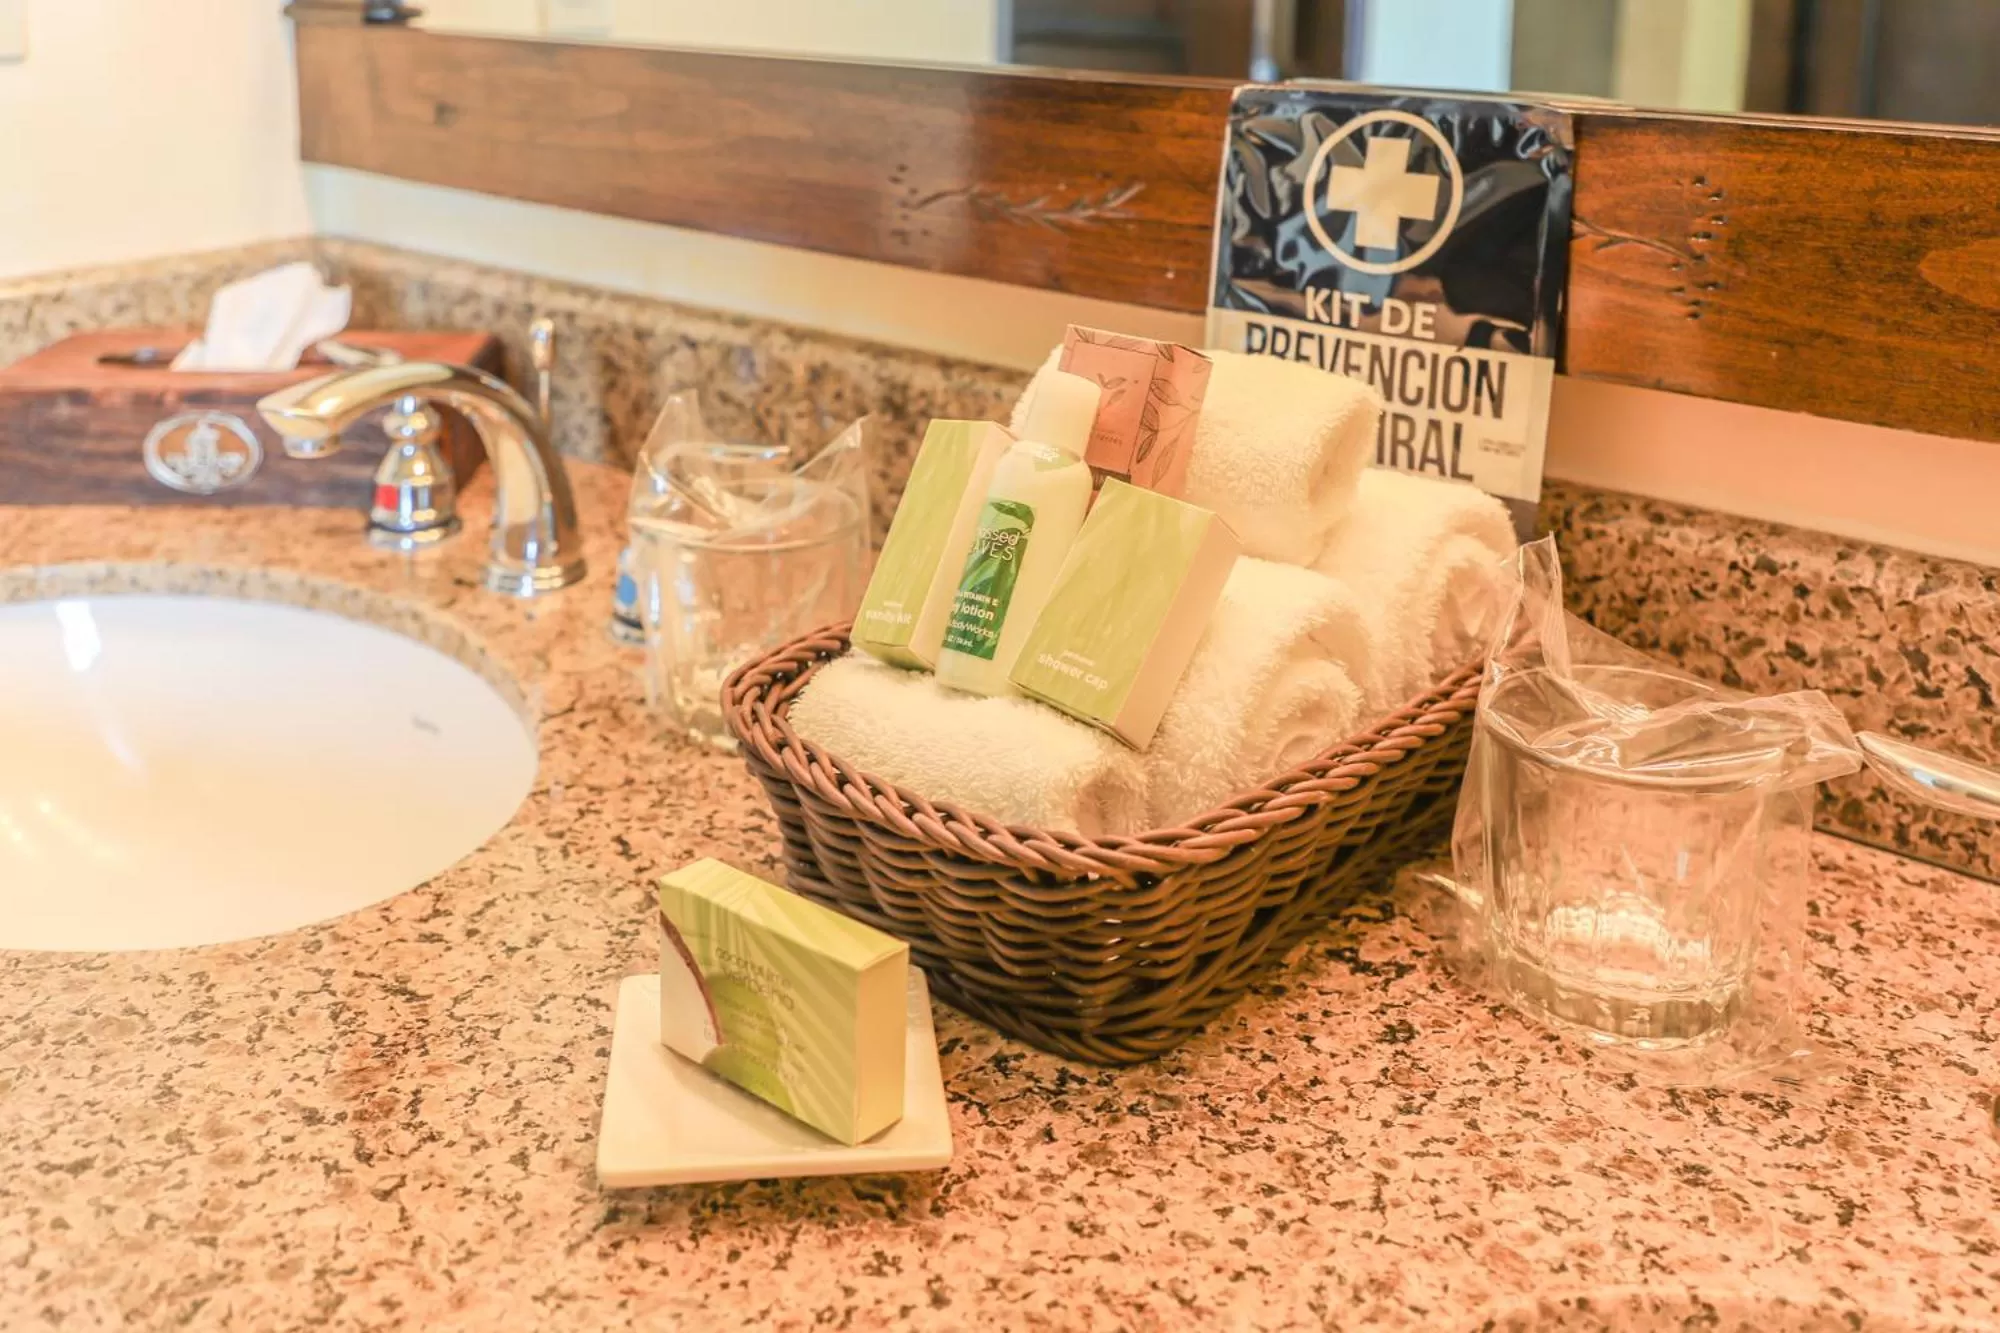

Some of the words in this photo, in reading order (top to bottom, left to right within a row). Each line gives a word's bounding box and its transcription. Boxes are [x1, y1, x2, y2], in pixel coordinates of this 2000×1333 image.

[1305, 286, 1371, 329] KIT
[1379, 297, 1438, 340] DE
[1376, 411, 1473, 482] IRAL
[960, 601, 995, 621] lotion
[1038, 653, 1084, 680] shower
[1085, 673, 1109, 692] cap
